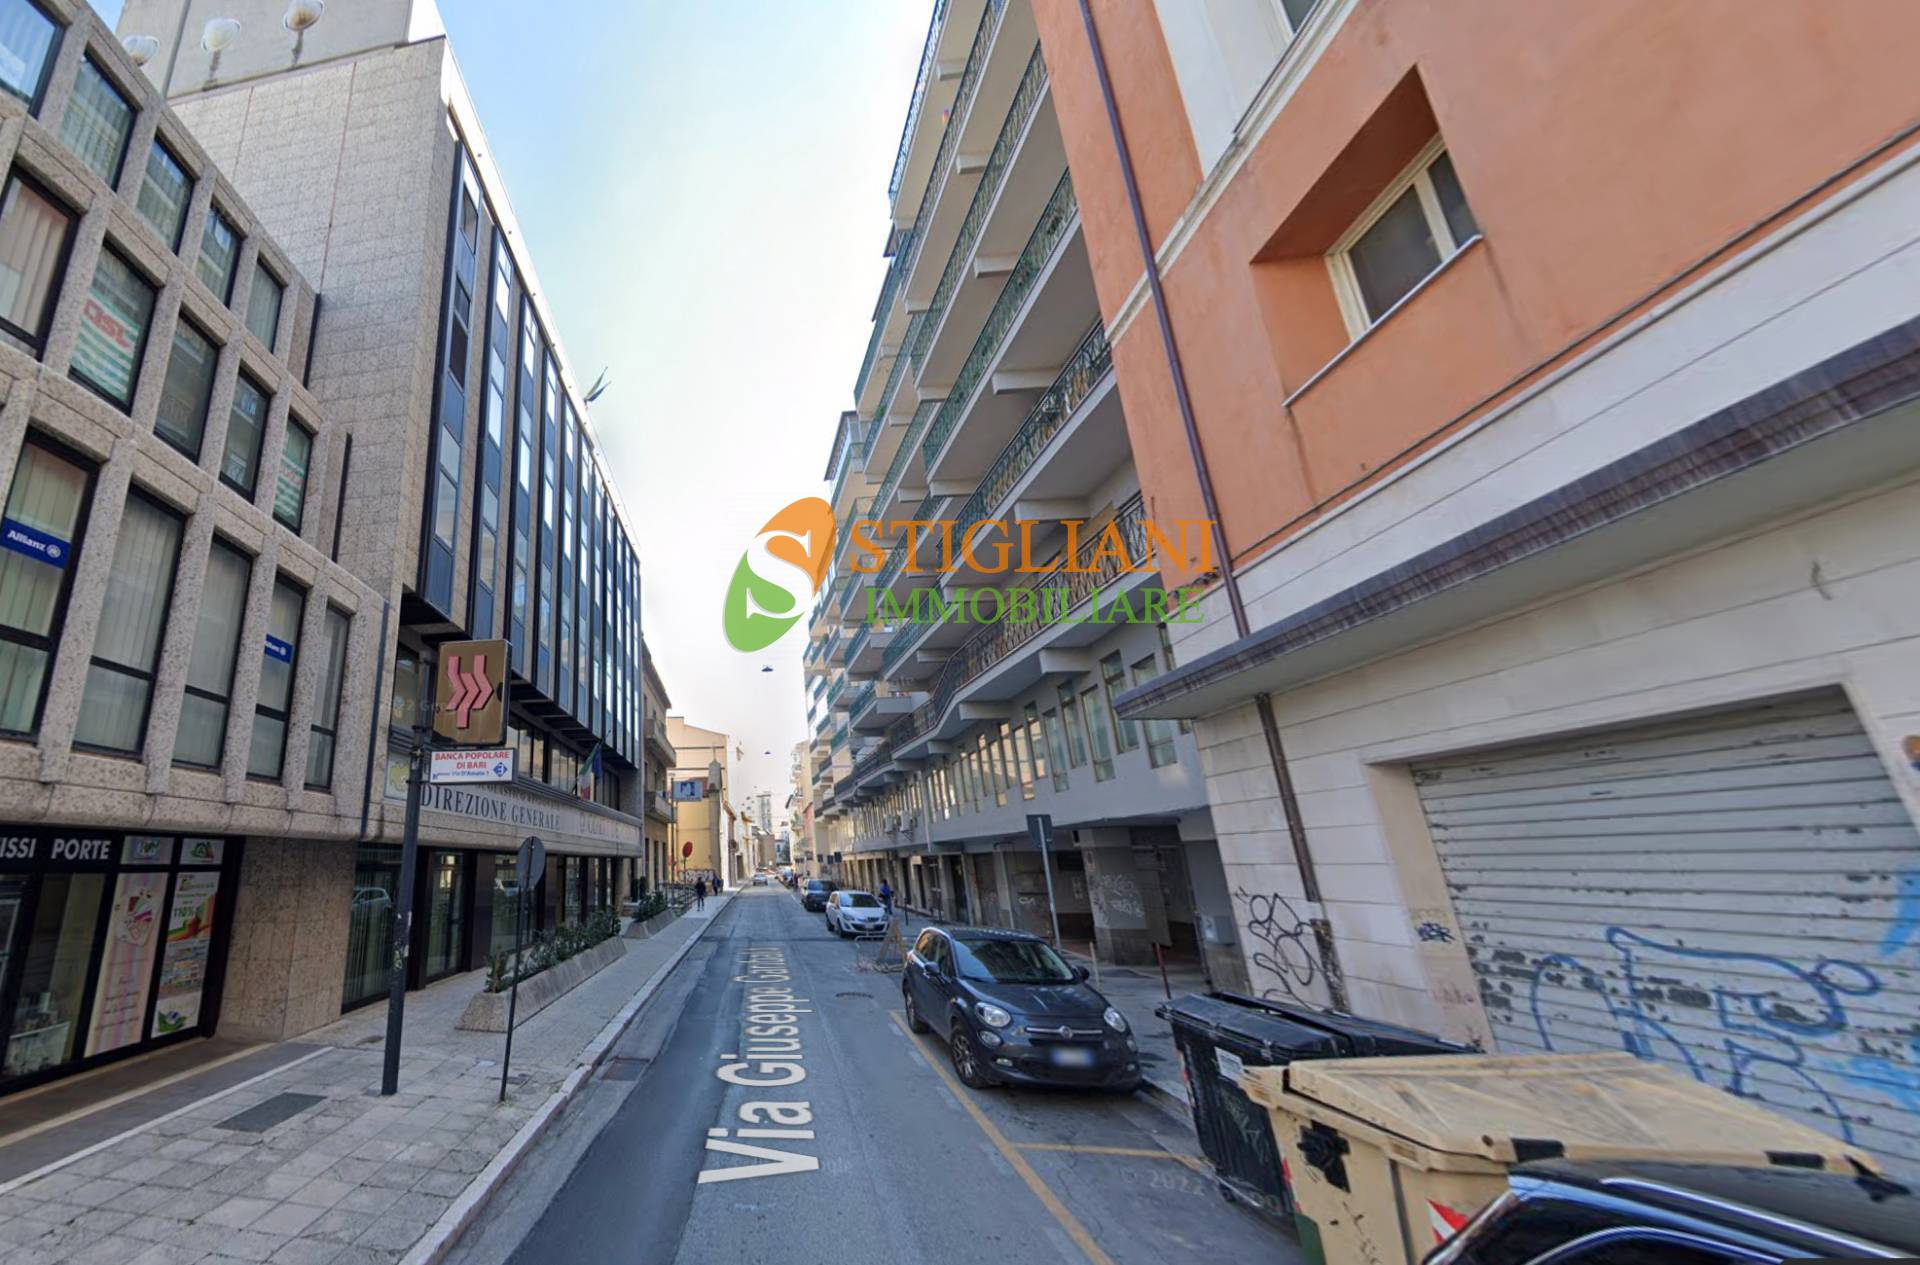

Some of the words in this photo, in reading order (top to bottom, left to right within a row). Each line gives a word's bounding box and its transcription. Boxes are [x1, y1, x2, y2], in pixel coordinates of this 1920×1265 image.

[7, 529, 46, 552] Allianz
[435, 752, 463, 761] BANCA
[466, 751, 510, 760] POPOLARE
[456, 762, 465, 770] DI
[467, 761, 487, 769] BARI
[421, 784, 507, 821] DIREZIONE
[511, 804, 560, 830] GENERALE
[51, 838, 112, 860] PORTE
